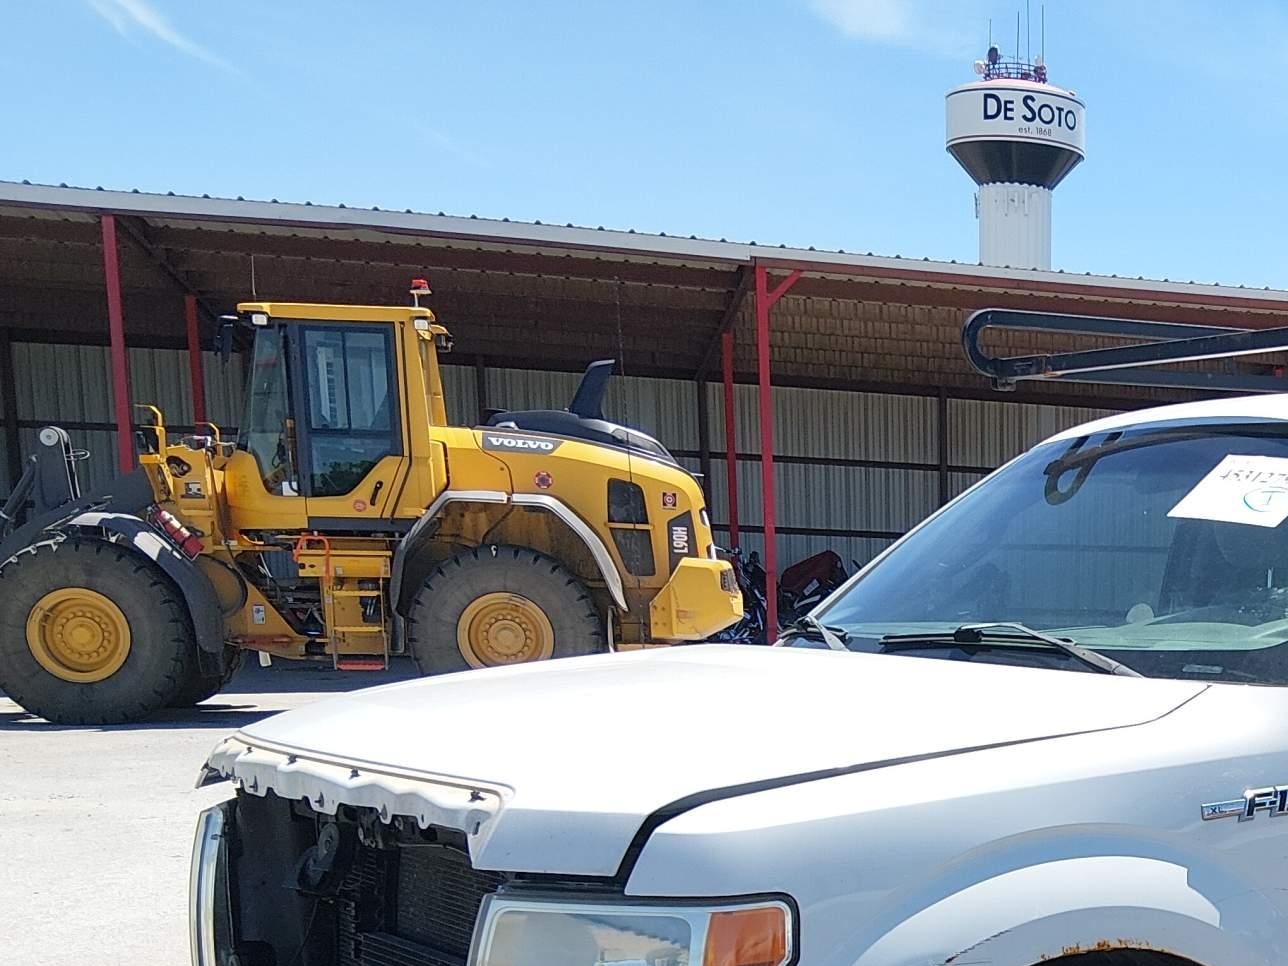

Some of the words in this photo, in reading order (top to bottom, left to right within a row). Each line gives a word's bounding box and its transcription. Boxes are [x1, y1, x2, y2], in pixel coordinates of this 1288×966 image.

[487, 436, 554, 450] VOLVO
[672, 526, 689, 554] L90H
[1209, 805, 1226, 815] XL
